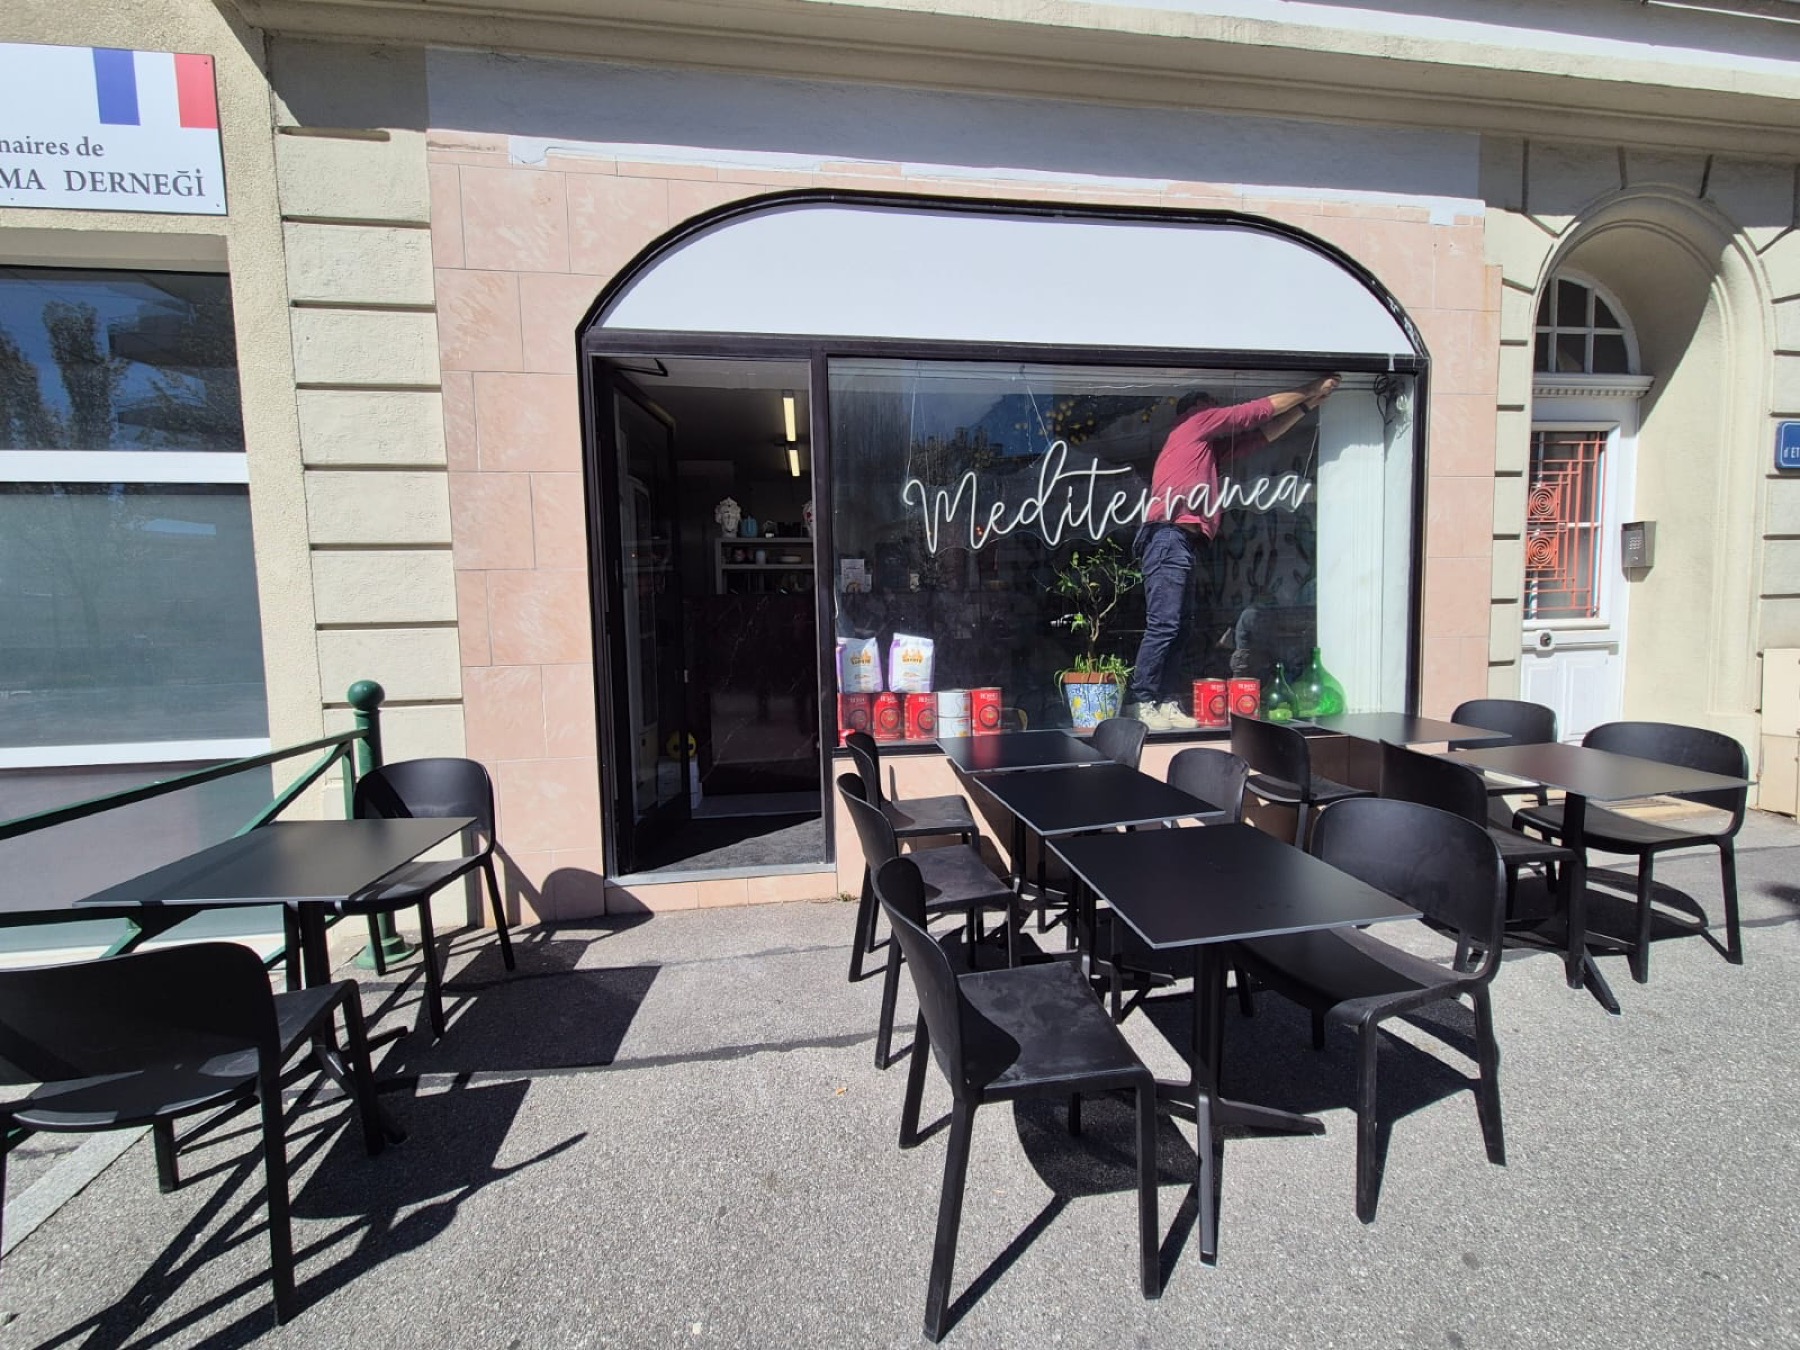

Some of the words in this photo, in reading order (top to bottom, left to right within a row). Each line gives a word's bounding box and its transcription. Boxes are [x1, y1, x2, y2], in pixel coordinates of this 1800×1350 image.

[0, 136, 69, 156] naires
[76, 136, 104, 156] de
[0, 168, 46, 190] MA
[903, 440, 1311, 554] Mediterranea
